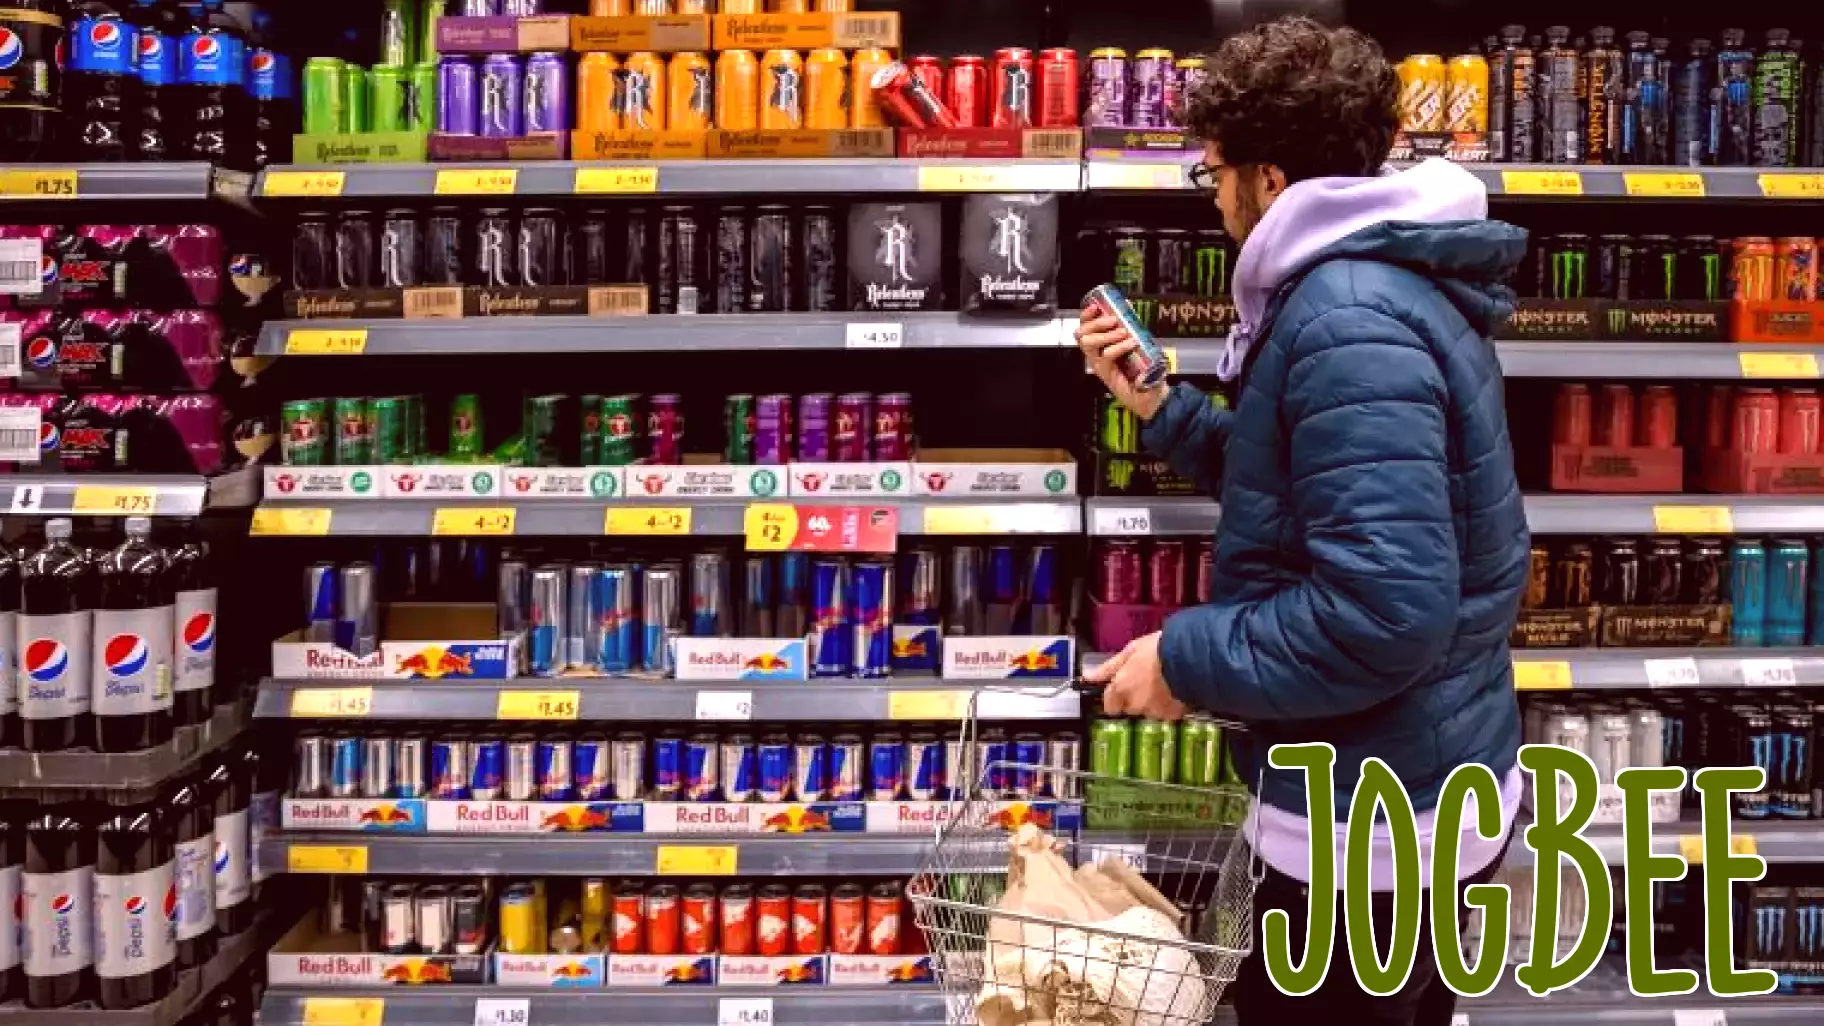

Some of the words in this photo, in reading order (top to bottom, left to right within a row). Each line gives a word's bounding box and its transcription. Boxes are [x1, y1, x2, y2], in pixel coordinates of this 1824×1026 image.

[1158, 301, 1237, 323] MONST
[291, 805, 315, 819] Red
[316, 805, 350, 819] Bull
[456, 805, 491, 821] Red
[495, 805, 529, 821] Bull
[676, 806, 711, 823] Red
[715, 806, 749, 823] Bull
[299, 958, 332, 975] Red
[335, 958, 373, 975] Bull
